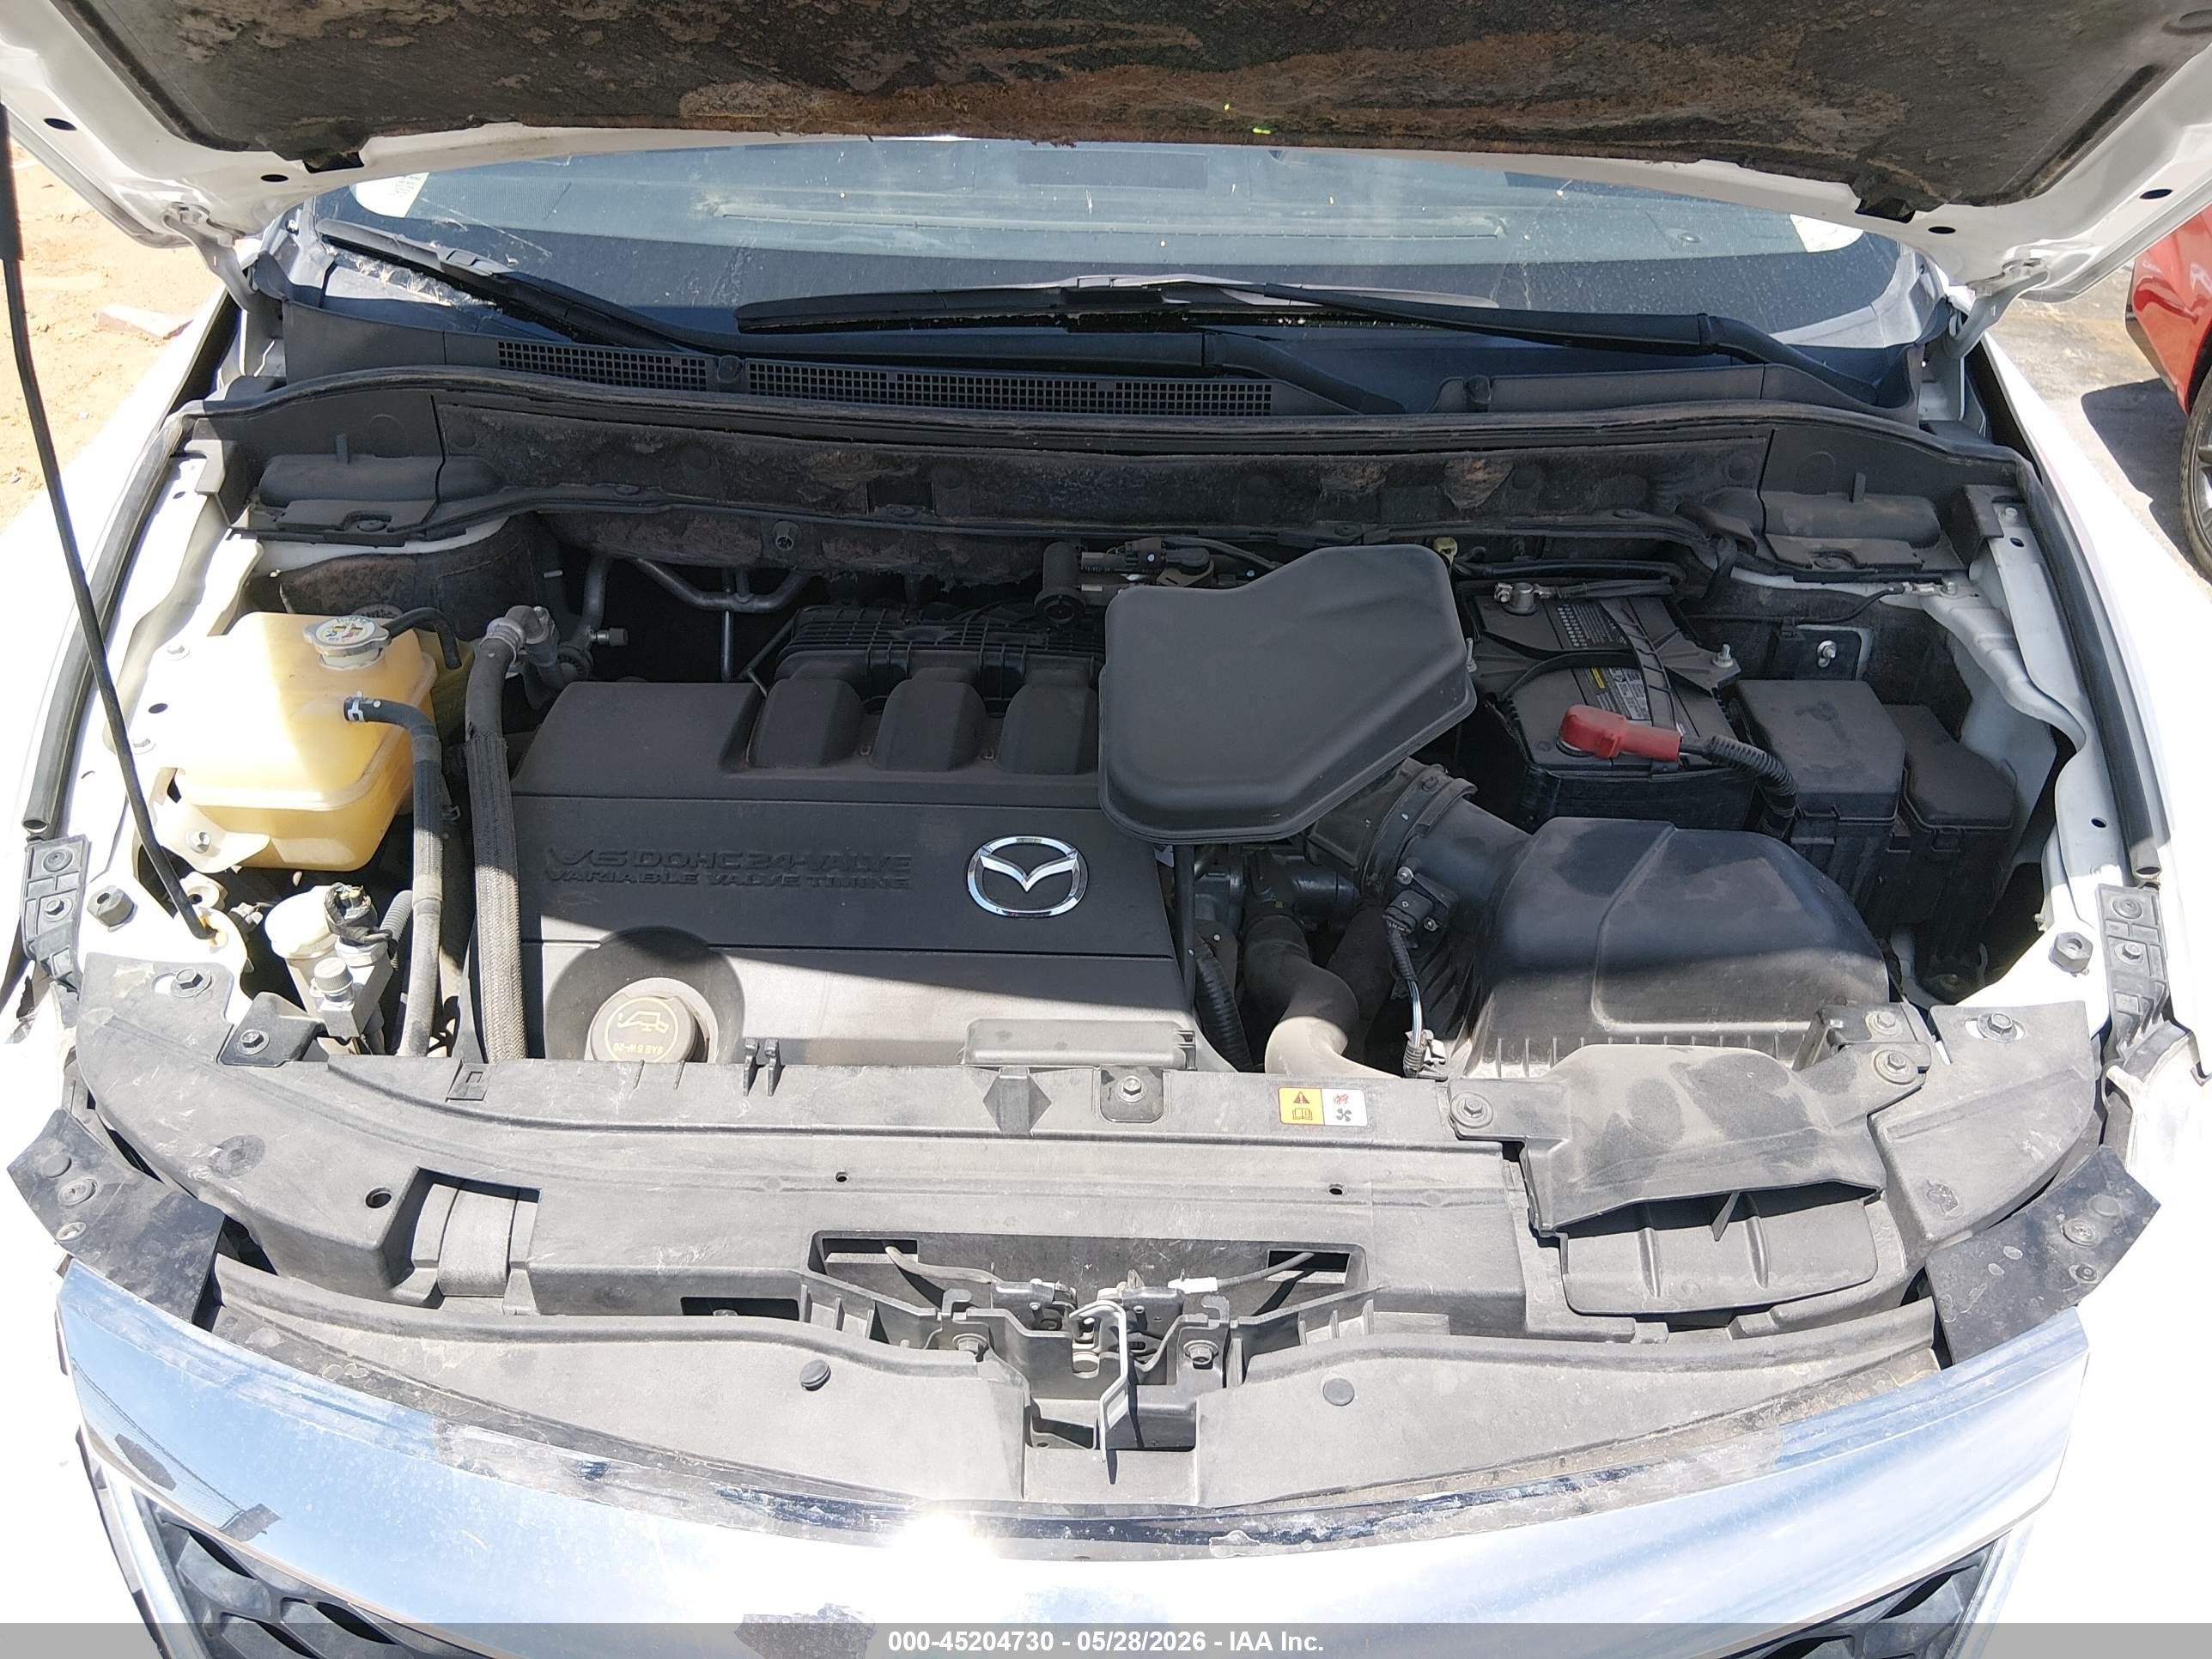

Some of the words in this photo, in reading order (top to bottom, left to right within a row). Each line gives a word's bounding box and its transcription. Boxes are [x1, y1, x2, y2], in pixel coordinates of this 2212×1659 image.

[546, 847, 628, 867] V6
[632, 848, 743, 869] DOHC
[746, 851, 913, 872] 24-VALVE
[545, 869, 700, 885] VARIABLE
[710, 872, 801, 887] VALVE
[806, 874, 913, 890] TIMING
[646, 1044, 664, 1055] SAE
